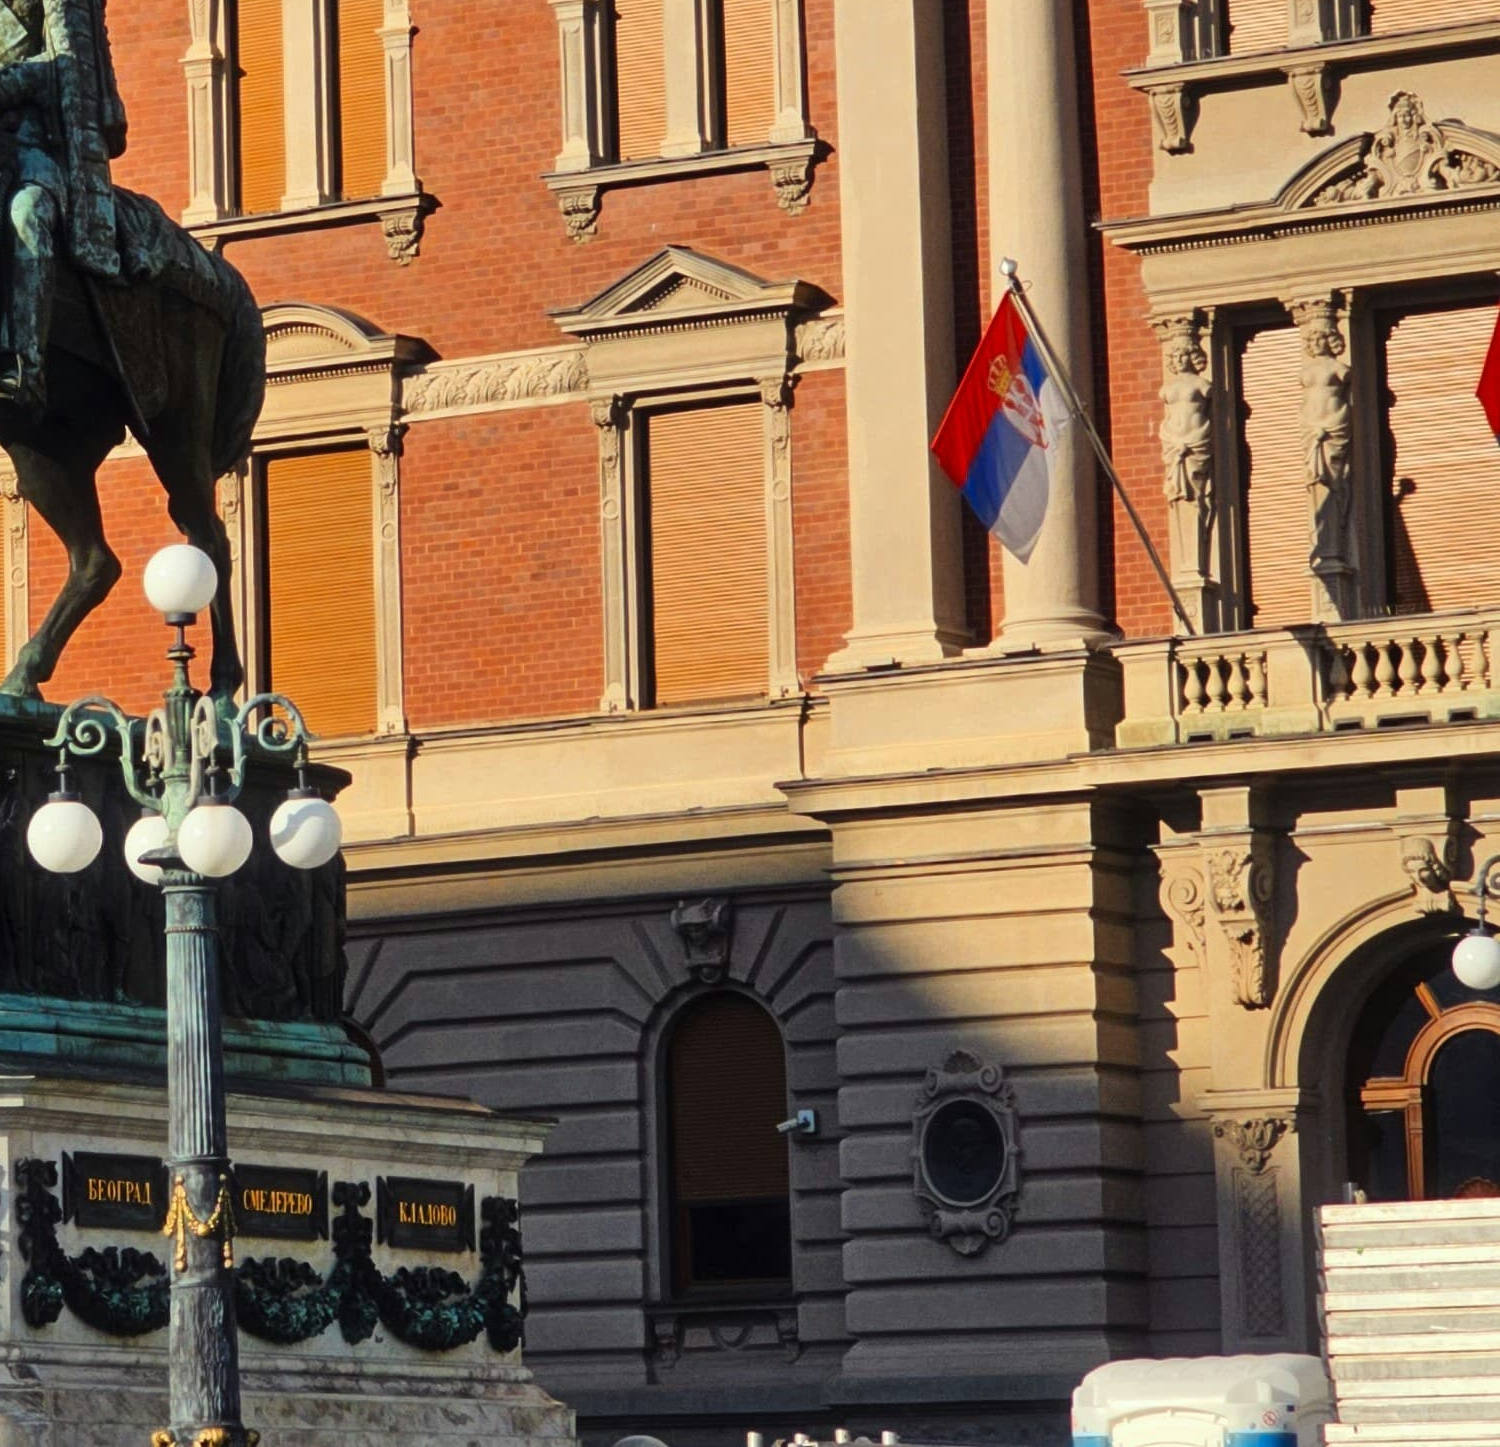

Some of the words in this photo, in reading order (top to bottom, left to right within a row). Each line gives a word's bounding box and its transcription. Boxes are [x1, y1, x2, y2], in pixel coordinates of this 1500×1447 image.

[87, 1177, 153, 1206] БЕОГРАД
[243, 1186, 313, 1216] СМЕДЕРЕВО
[398, 1200, 457, 1227] КЛАДОВО
